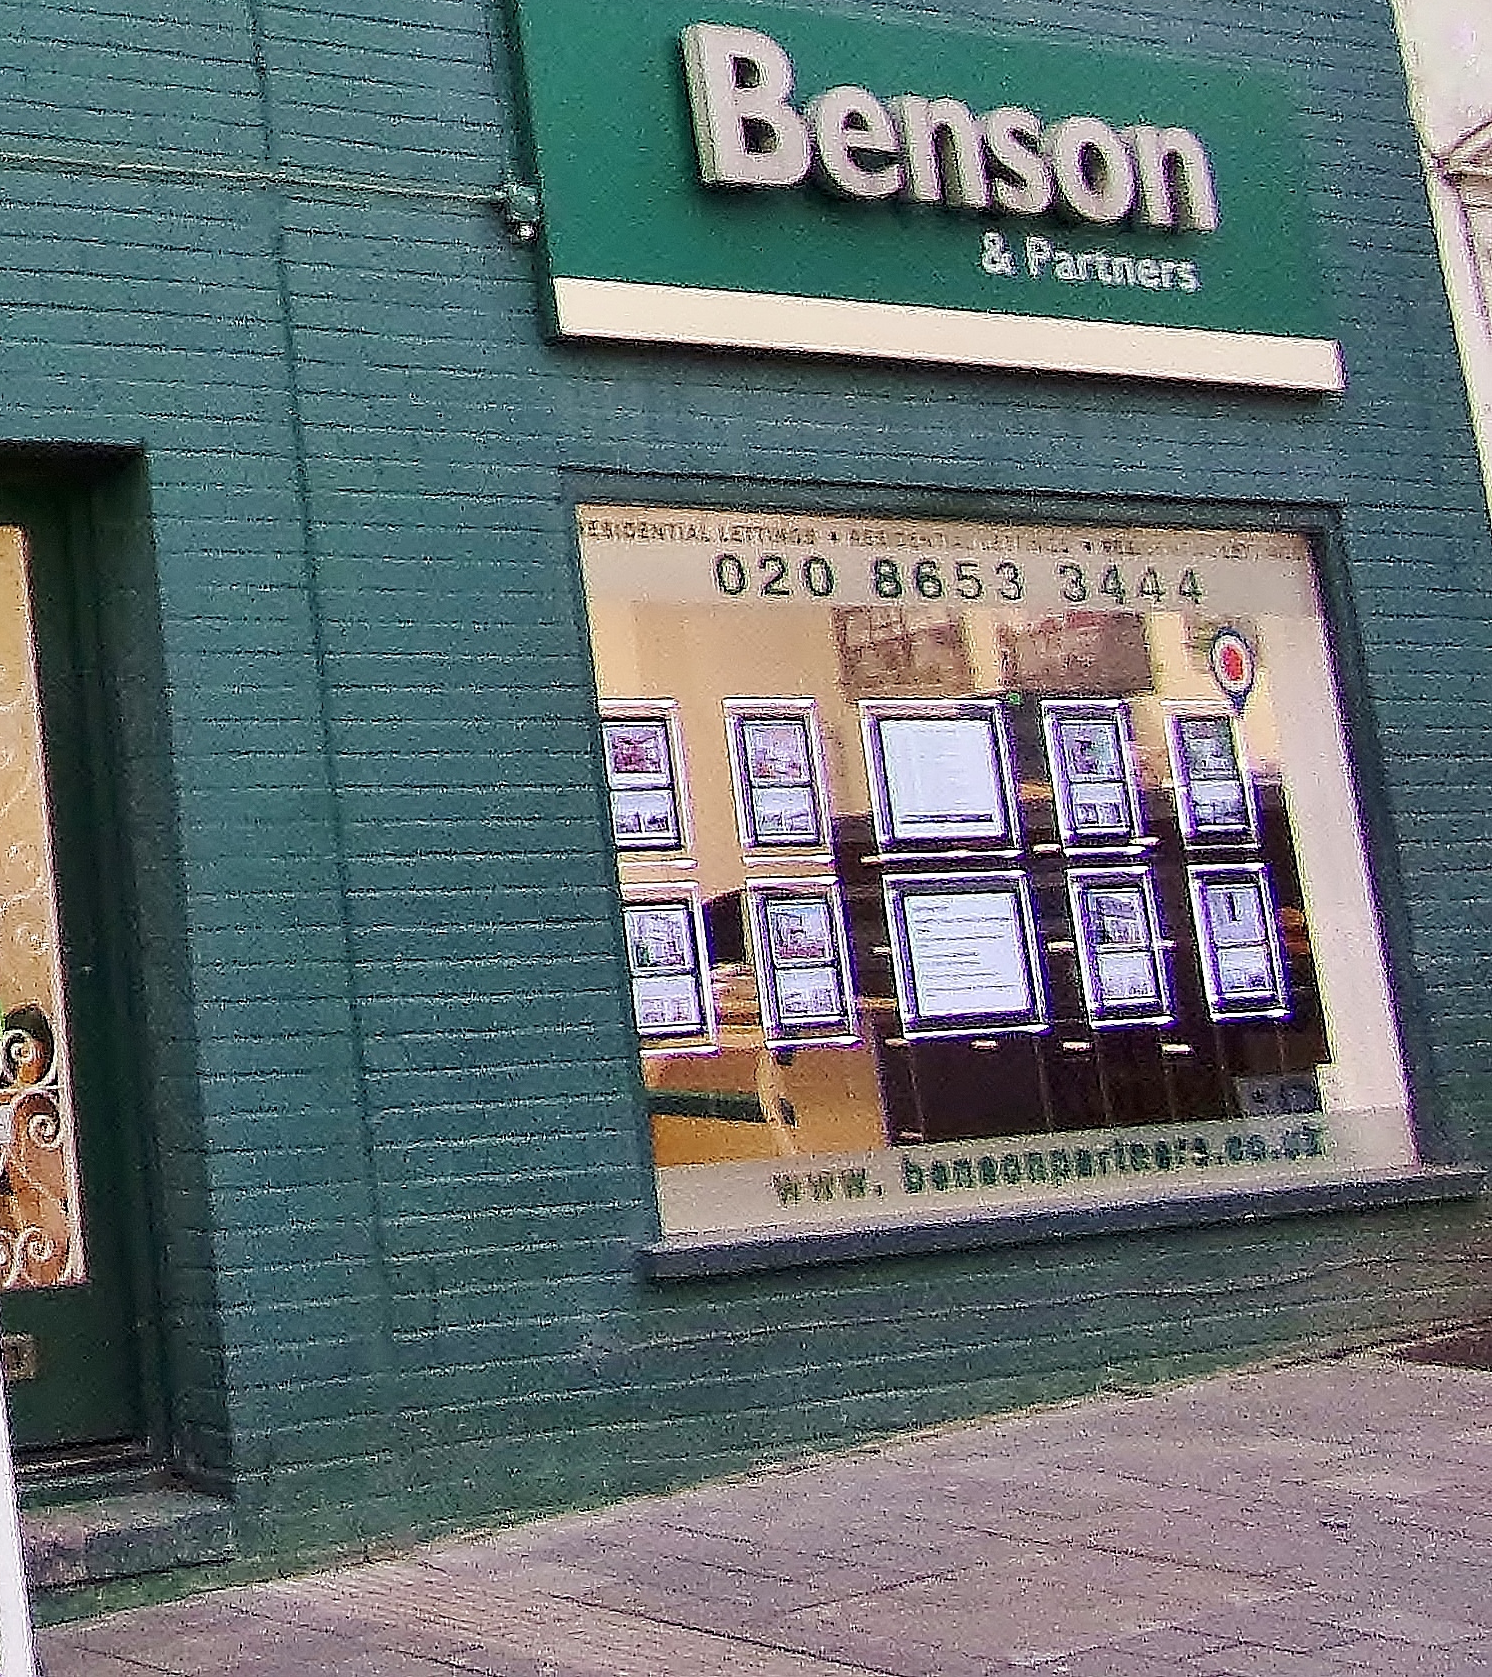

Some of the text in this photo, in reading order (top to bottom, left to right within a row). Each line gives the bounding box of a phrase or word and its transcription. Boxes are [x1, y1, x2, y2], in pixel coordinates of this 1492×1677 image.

[680, 20, 1220, 233] Benson
[980, 231, 1202, 292] & Partners
[715, 551, 1204, 605] 020 8653 3444
